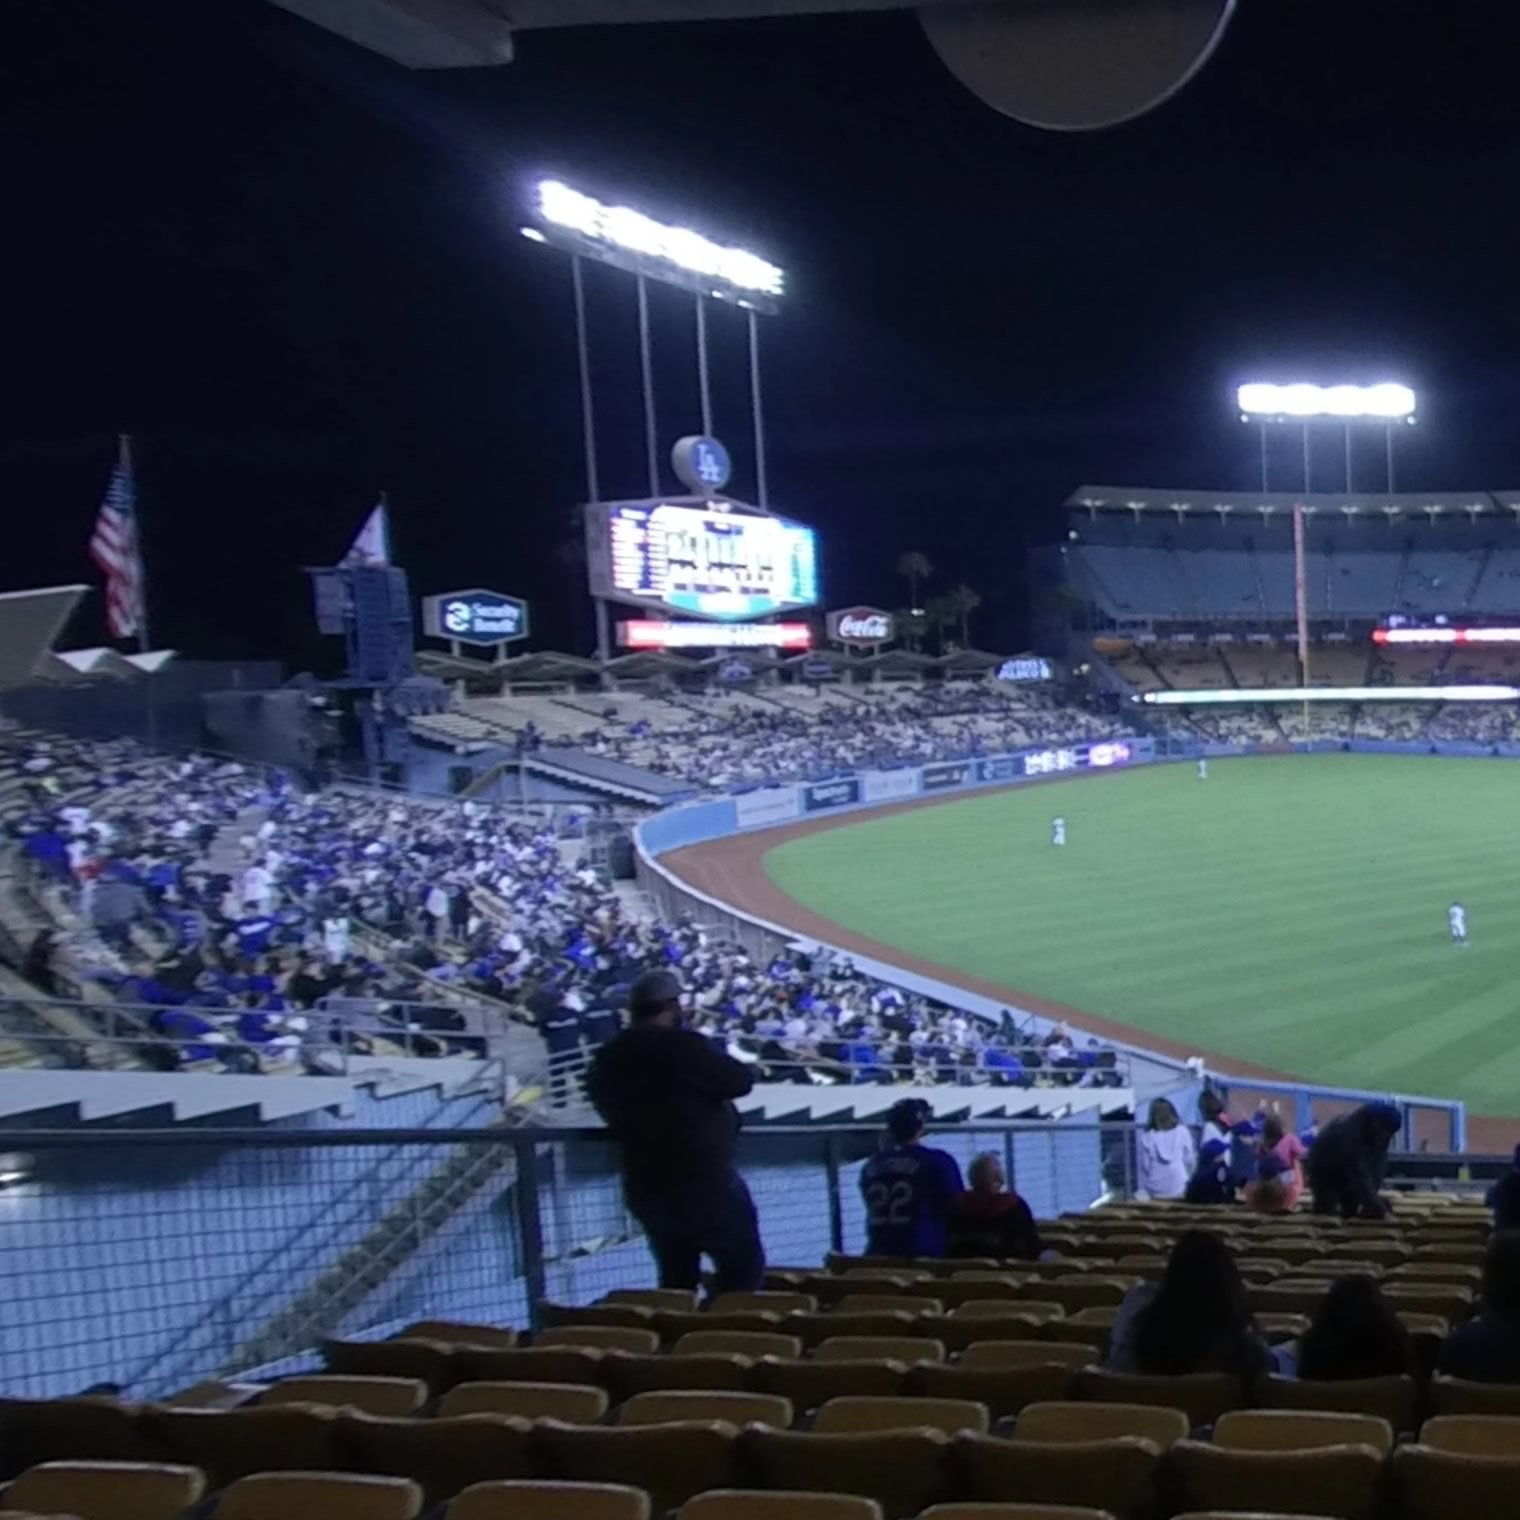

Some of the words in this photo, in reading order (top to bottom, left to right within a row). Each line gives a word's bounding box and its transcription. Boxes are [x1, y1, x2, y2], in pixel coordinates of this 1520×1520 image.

[697, 443, 721, 482] LA
[472, 602, 520, 620] Security
[473, 618, 516, 632] Benefit
[868, 1181, 913, 1224] 22
